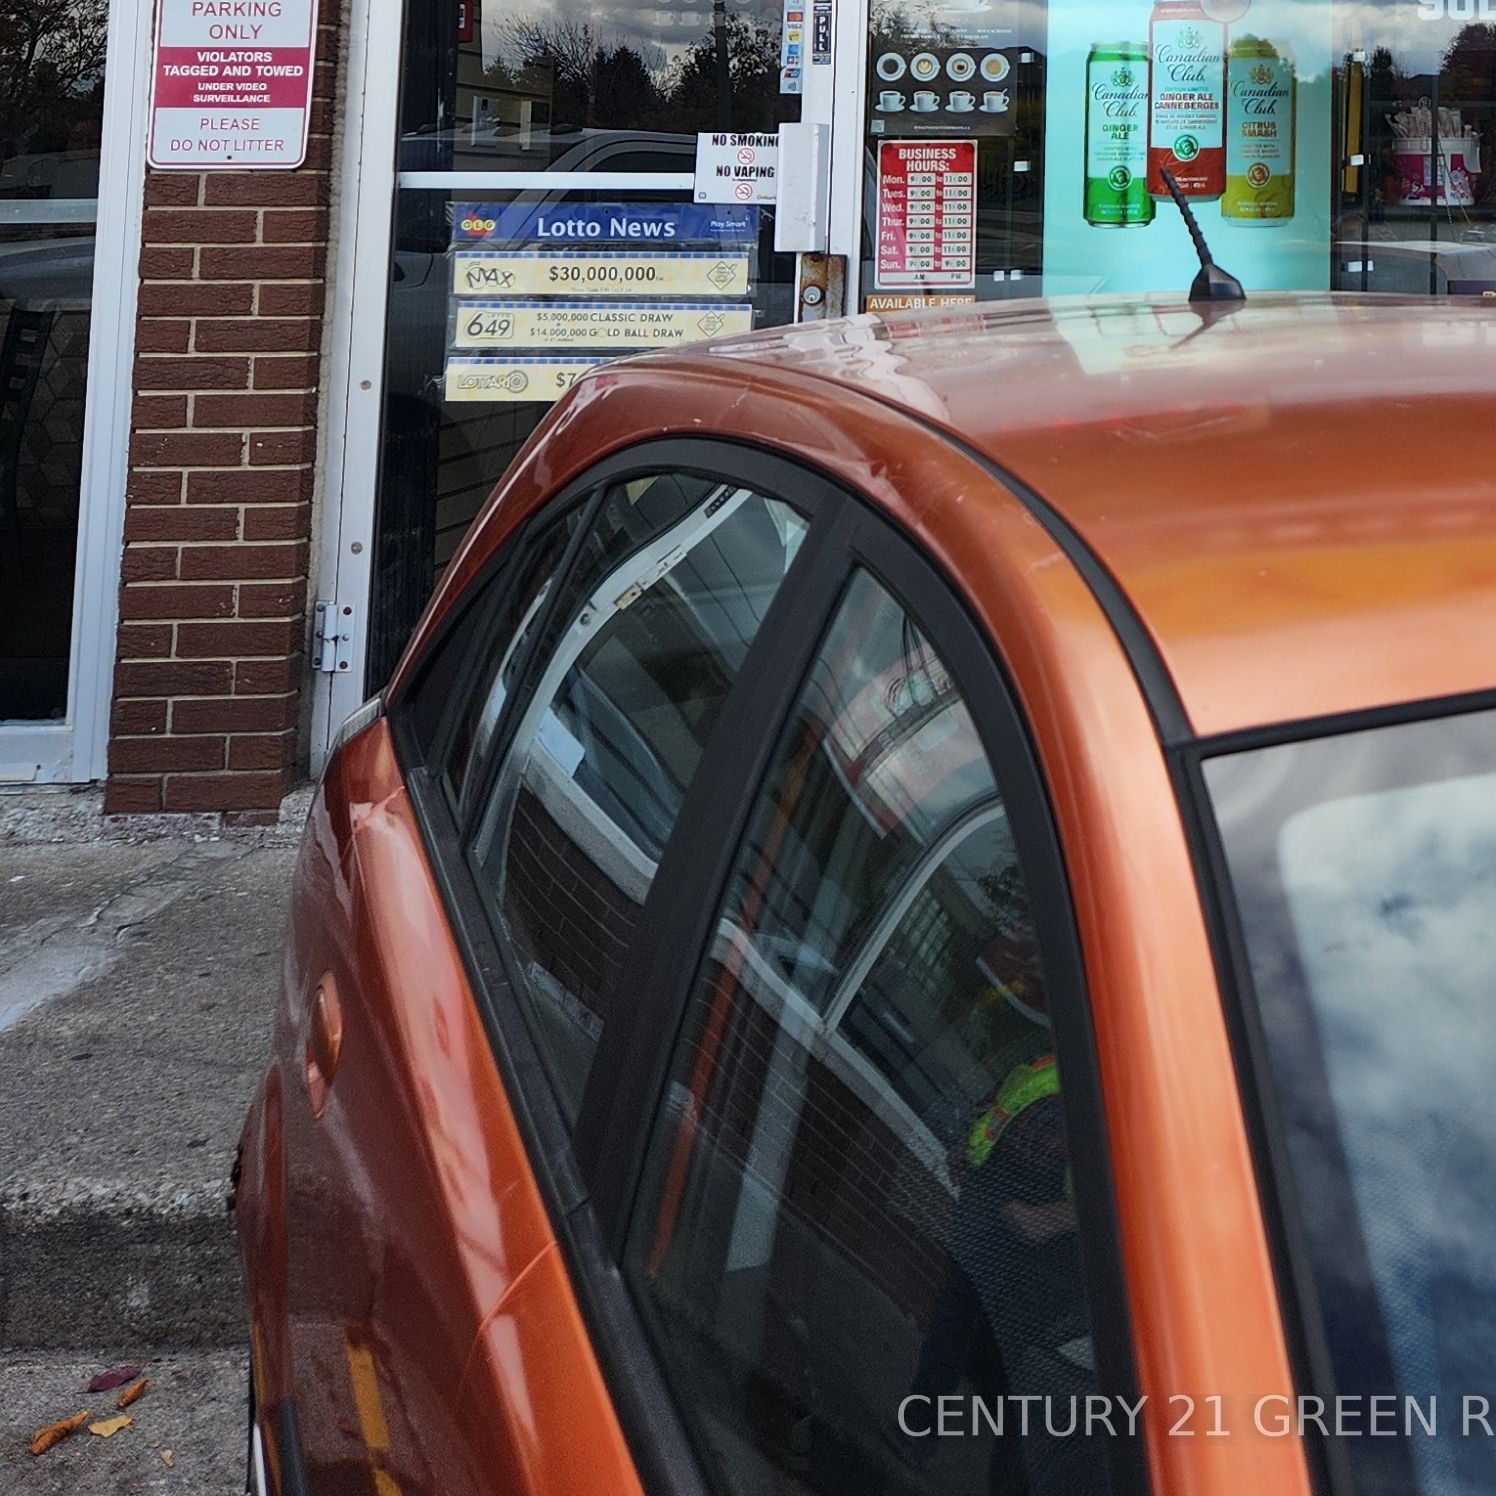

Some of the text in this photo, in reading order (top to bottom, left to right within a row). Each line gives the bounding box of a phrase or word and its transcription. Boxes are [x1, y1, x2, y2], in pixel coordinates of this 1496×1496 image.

[192, 2, 282, 17] PARKING
[209, 24, 262, 39] ONLY
[197, 52, 272, 62] VIOLATORS
[1155, 44, 1221, 63] Canadian
[163, 65, 303, 76] TAGGED AND TOWED
[1167, 64, 1205, 82] Club
[198, 83, 267, 91] UNDER VIDEO
[1230, 81, 1290, 98] Canadian
[193, 94, 271, 103] SURVEILLANCE
[1197, 93, 1215, 101] ALE
[1104, 101, 1137, 118] Club
[1242, 98, 1276, 115] Club
[200, 118, 260, 130] PLEASE
[1242, 121, 1276, 129] CITRUS
[1111, 132, 1129, 140] ALE
[1241, 129, 1277, 137] SMASH
[171, 139, 284, 151] DO NOT LITTER
[712, 134, 727, 146] NO
[899, 148, 957, 160] BUSINESS
[716, 165, 775, 178] NO VAPING
[906, 160, 950, 172] HOURS:
[882, 176, 905, 184] Mon.
[882, 190, 906, 198] Tues.
[882, 204, 905, 212] Wed.
[461, 219, 496, 231] OLG
[537, 217, 601, 237] Lotto
[610, 217, 676, 237] News
[882, 217, 905, 226] Thur.
[882, 231, 896, 240] Fri.
[881, 246, 898, 254] Sat.
[880, 260, 901, 269] Sun.
[466, 266, 656, 288] MAX $30,000,000
[870, 297, 936, 309] AVAILABLE
[467, 312, 511, 337] 649
[590, 313, 636, 322] CLASSIC
[640, 313, 673, 322] DRAW
[624, 329, 648, 337] BALL
[653, 329, 683, 338] DRAW
